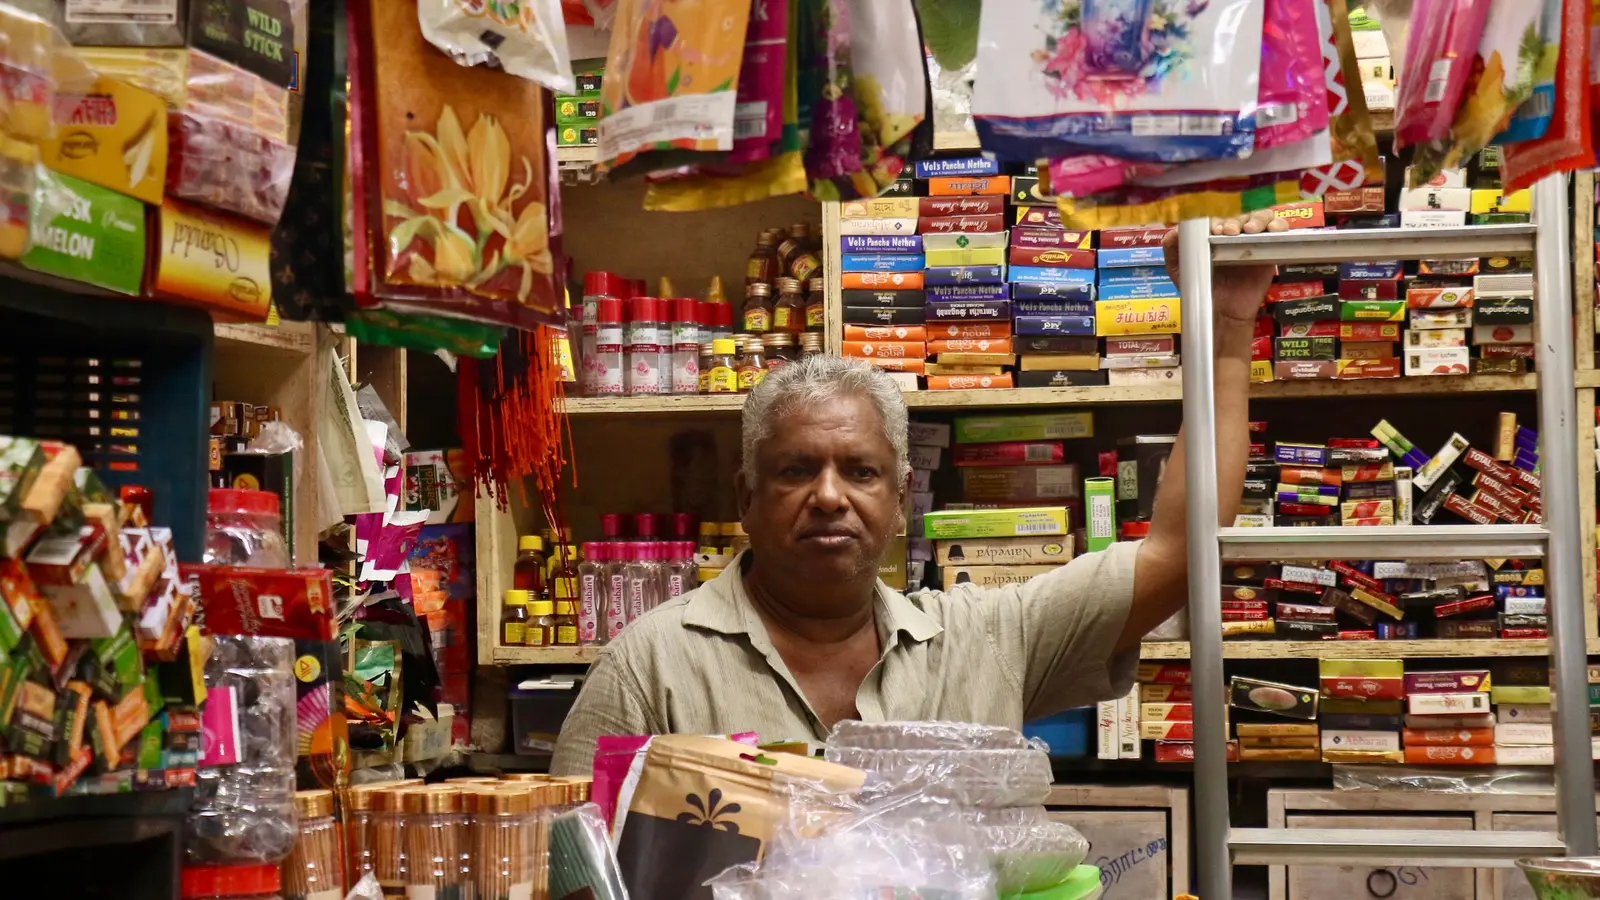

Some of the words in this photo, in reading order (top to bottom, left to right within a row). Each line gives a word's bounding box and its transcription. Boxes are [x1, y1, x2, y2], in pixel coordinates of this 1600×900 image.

[248, 7, 281, 37] WILD
[244, 29, 282, 62] STICK
[942, 160, 965, 170] Pancha
[968, 159, 991, 169] Nethra
[932, 202, 958, 214] Indian
[960, 198, 988, 212] Proudly
[932, 221, 958, 232] Indian
[960, 218, 988, 231] Proudly
[171, 222, 240, 272] Sandal
[848, 237, 865, 247] Vel's
[867, 237, 889, 247] Pancha
[892, 237, 916, 247] Nethra
[1114, 236, 1141, 246] Indian
[953, 286, 977, 294] Pancha
[979, 285, 1002, 294] Nethra
[937, 308, 966, 317] Sugandh
[970, 308, 998, 316] Amrutha
[1065, 303, 1089, 311] Nethra
[1285, 304, 1333, 316] Rajanigandha
[1140, 342, 1160, 352] Fresh
[1510, 348, 1534, 356] Fresh
[1470, 451, 1491, 467] TOTAL
[1488, 462, 1511, 480] Fresh
[1520, 471, 1541, 486] TOTAL
[1480, 474, 1502, 491] TOTAL
[1498, 487, 1521, 504] Fresh
[1451, 496, 1472, 513] Fresh
[1480, 492, 1500, 509] TOTAL
[1497, 505, 1520, 522] Fresh
[1468, 510, 1490, 524] TOTAL
[976, 546, 1032, 560] Naivedya
[983, 572, 1033, 589] aivedya
